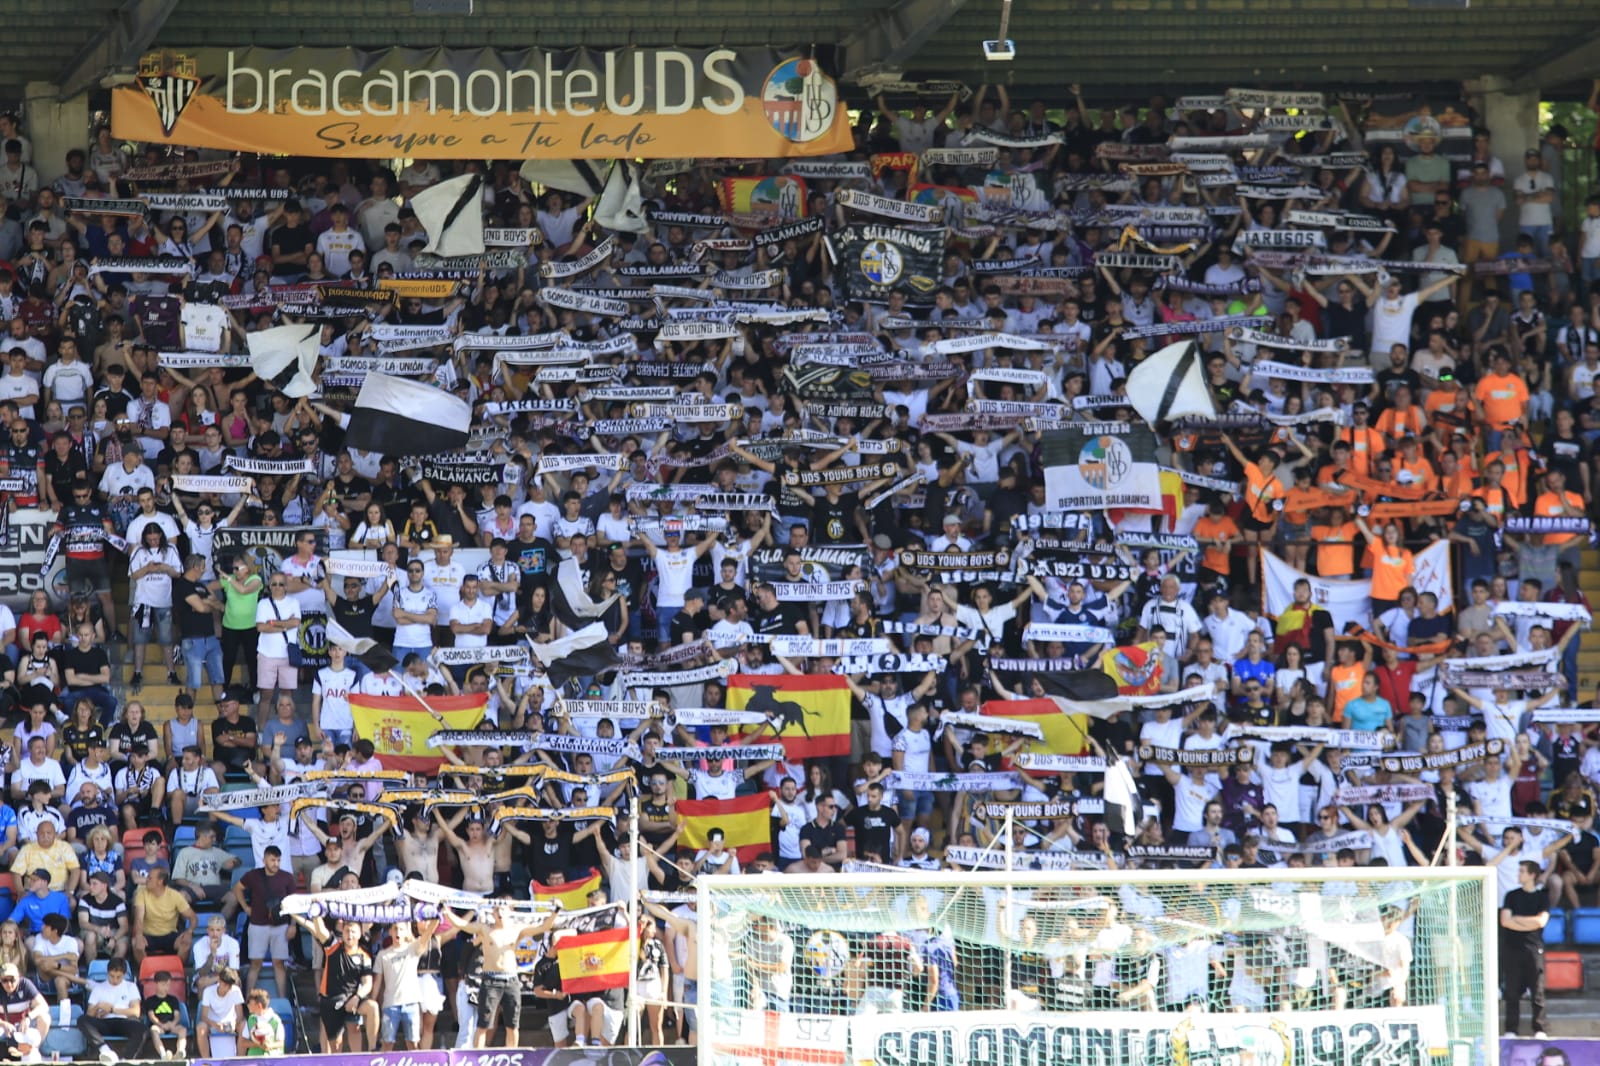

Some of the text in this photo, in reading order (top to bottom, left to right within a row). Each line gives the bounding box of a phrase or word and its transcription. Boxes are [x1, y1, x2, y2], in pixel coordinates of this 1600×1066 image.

[226, 50, 745, 117] bracamonteUDS
[316, 121, 657, 154] Siempre a Tu lado
[270, 188, 288, 199] UDS
[149, 199, 204, 208] ALAMANCA
[852, 192, 927, 218] UDS YOUNG BOYS
[503, 230, 527, 242] BOYS
[862, 225, 932, 254] SALAMANCA
[711, 239, 751, 249] SALAMA
[547, 292, 574, 305] SOMOS
[590, 300, 603, 310] LA
[683, 324, 713, 336] YOUNG
[159, 357, 220, 366] alamanca
[340, 359, 367, 371] SOMOS
[384, 360, 396, 371] LA
[649, 404, 727, 417] UDS YOUNG BOYS
[594, 456, 617, 467] BOYS
[424, 467, 499, 484] SALAMANCA
[801, 465, 880, 485] UDS YOUNG BOYS
[177, 477, 248, 489] bracamonteUDS
[1058, 494, 1150, 508] DEPORTIVA SALAMANCA
[1506, 518, 1590, 531] SALAMANCA
[241, 531, 295, 547] SALAMAN
[1126, 533, 1156, 545] HALA
[799, 547, 863, 567] ALAMANCA
[916, 553, 994, 567] UDS YOUNG BOYS
[826, 581, 850, 595] BOYS
[443, 649, 502, 661] SOMOS LA
[565, 702, 647, 715] UDS YOUNG BOYS
[1154, 747, 1237, 764] UDS YOUNG BOYS
[1401, 745, 1486, 772] UDS YOUNG BOYS
[1044, 802, 1070, 816] BOYS
[77, 813, 107, 828] GANT
